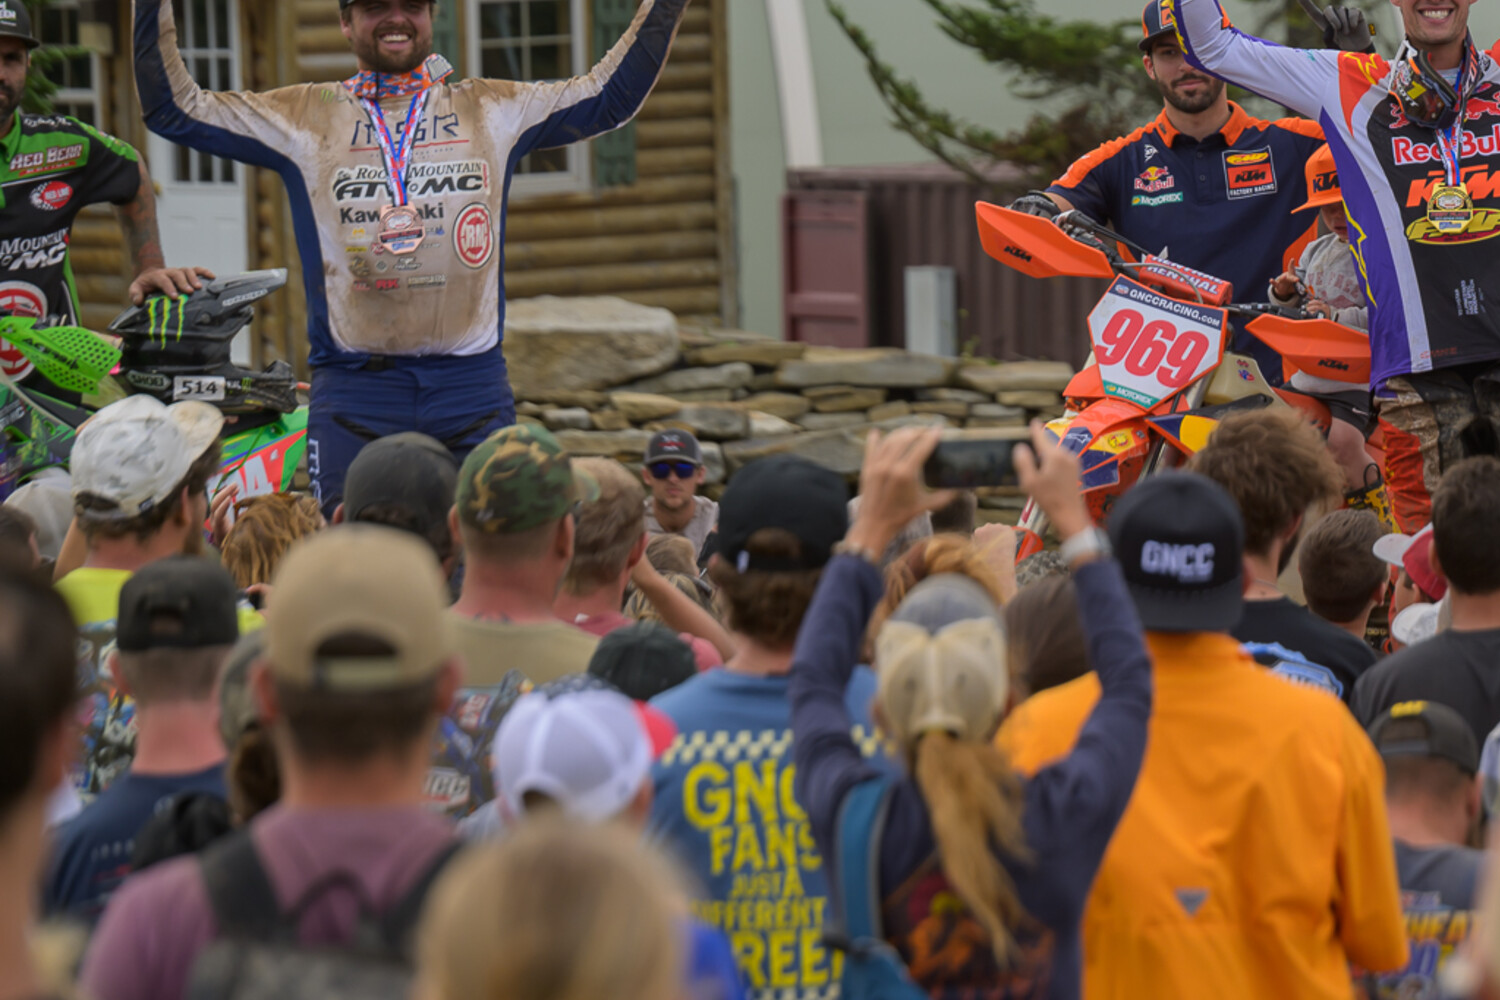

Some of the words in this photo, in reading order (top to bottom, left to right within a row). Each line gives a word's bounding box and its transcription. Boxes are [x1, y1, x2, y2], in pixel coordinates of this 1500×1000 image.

[9, 151, 43, 172] RED
[355, 166, 388, 181] ROC
[407, 161, 482, 180] MOUNTAIN
[1134, 177, 1153, 193] Red
[1153, 175, 1175, 191] Bull
[1234, 169, 1266, 183] KTM
[340, 202, 444, 225] Kawaki
[1003, 244, 1032, 264] KTM
[1129, 288, 1221, 327] GNCCRACING.COM
[1095, 308, 1210, 389] 969
[1317, 358, 1350, 372] KTM
[181, 380, 218, 395] 514
[1141, 539, 1215, 577] GNCC
[683, 757, 809, 830] GNC
[729, 929, 846, 989] REE
